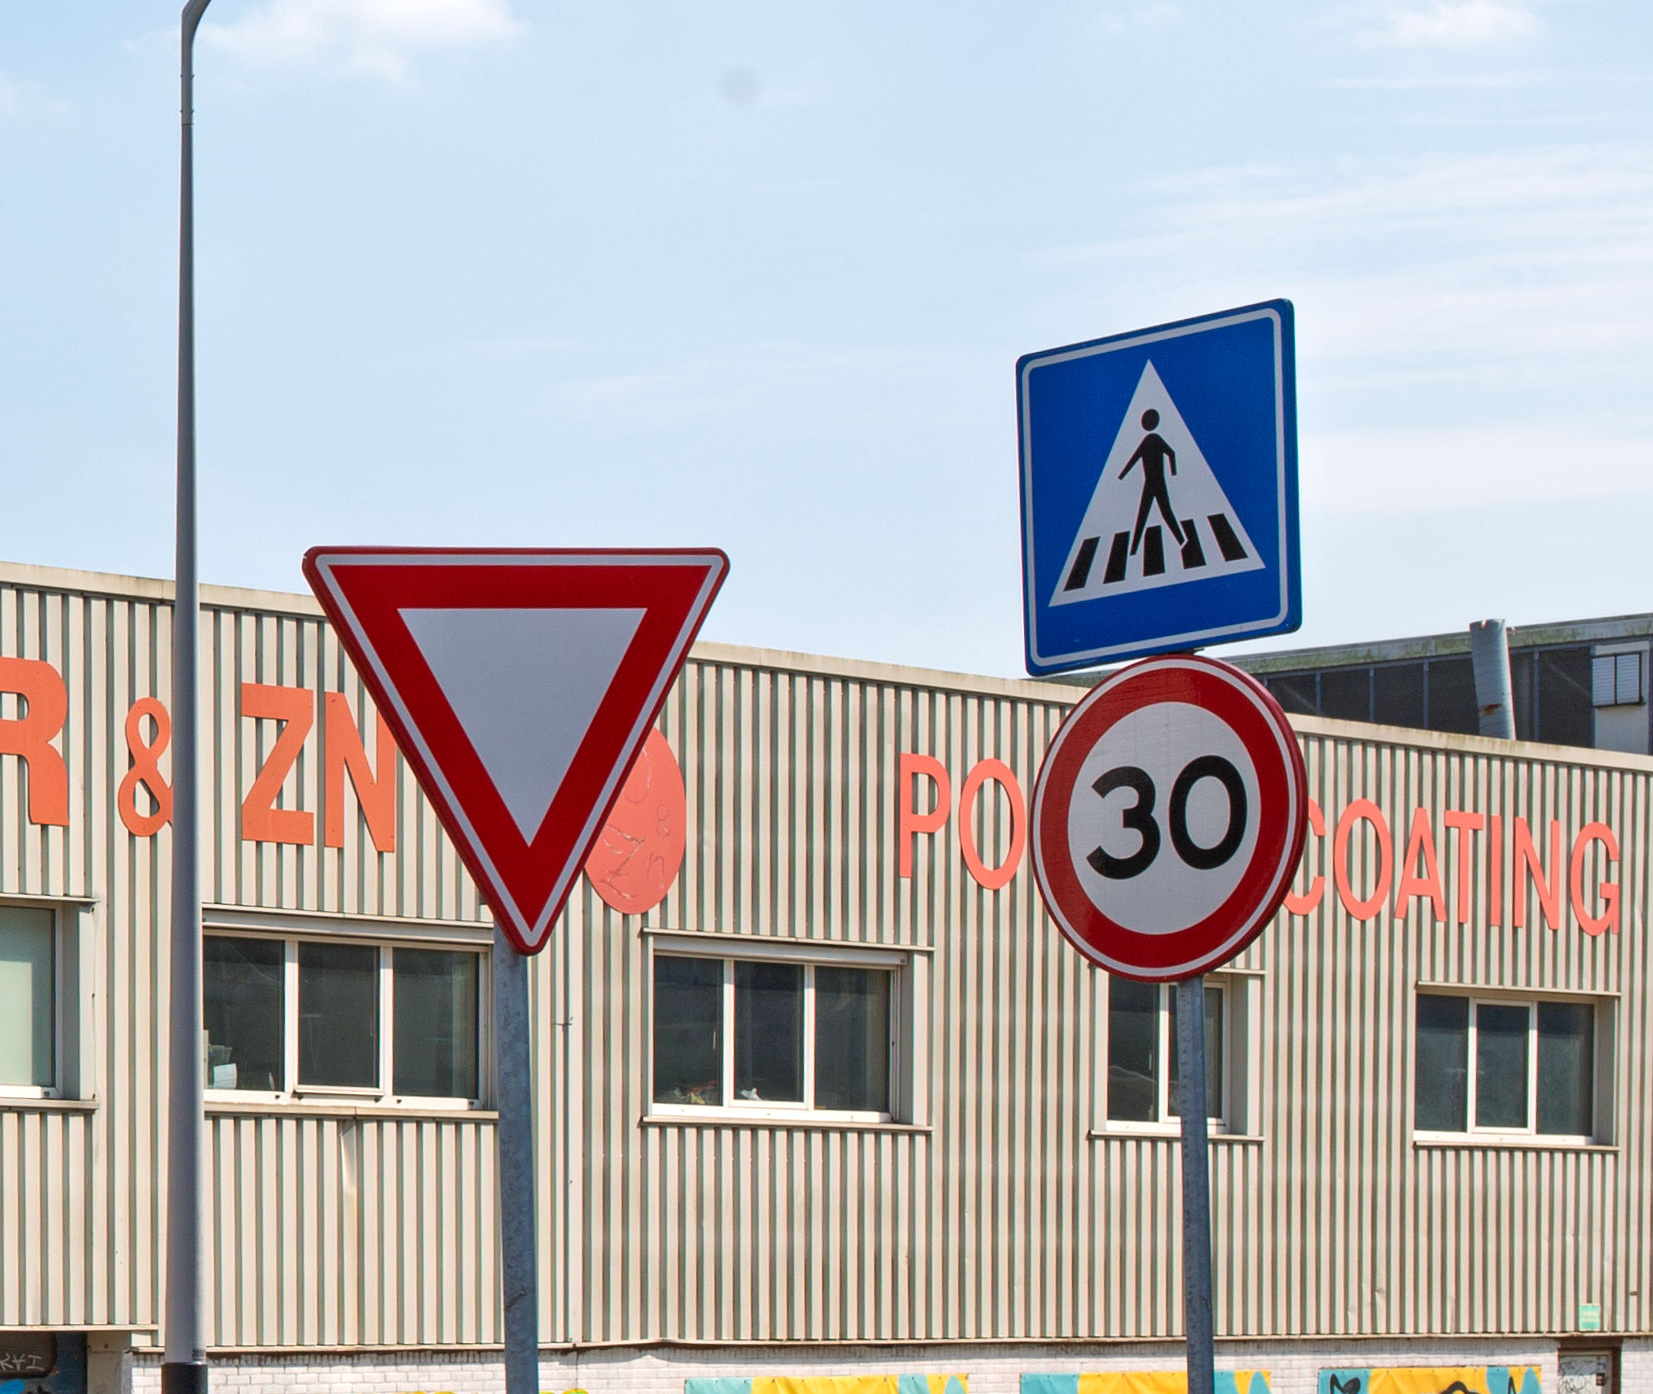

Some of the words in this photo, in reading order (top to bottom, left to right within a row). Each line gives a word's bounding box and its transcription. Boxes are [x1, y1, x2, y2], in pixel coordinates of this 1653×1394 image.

[117, 696, 174, 837] &
[241, 682, 397, 853] ZN
[1086, 755, 1248, 880] 30
